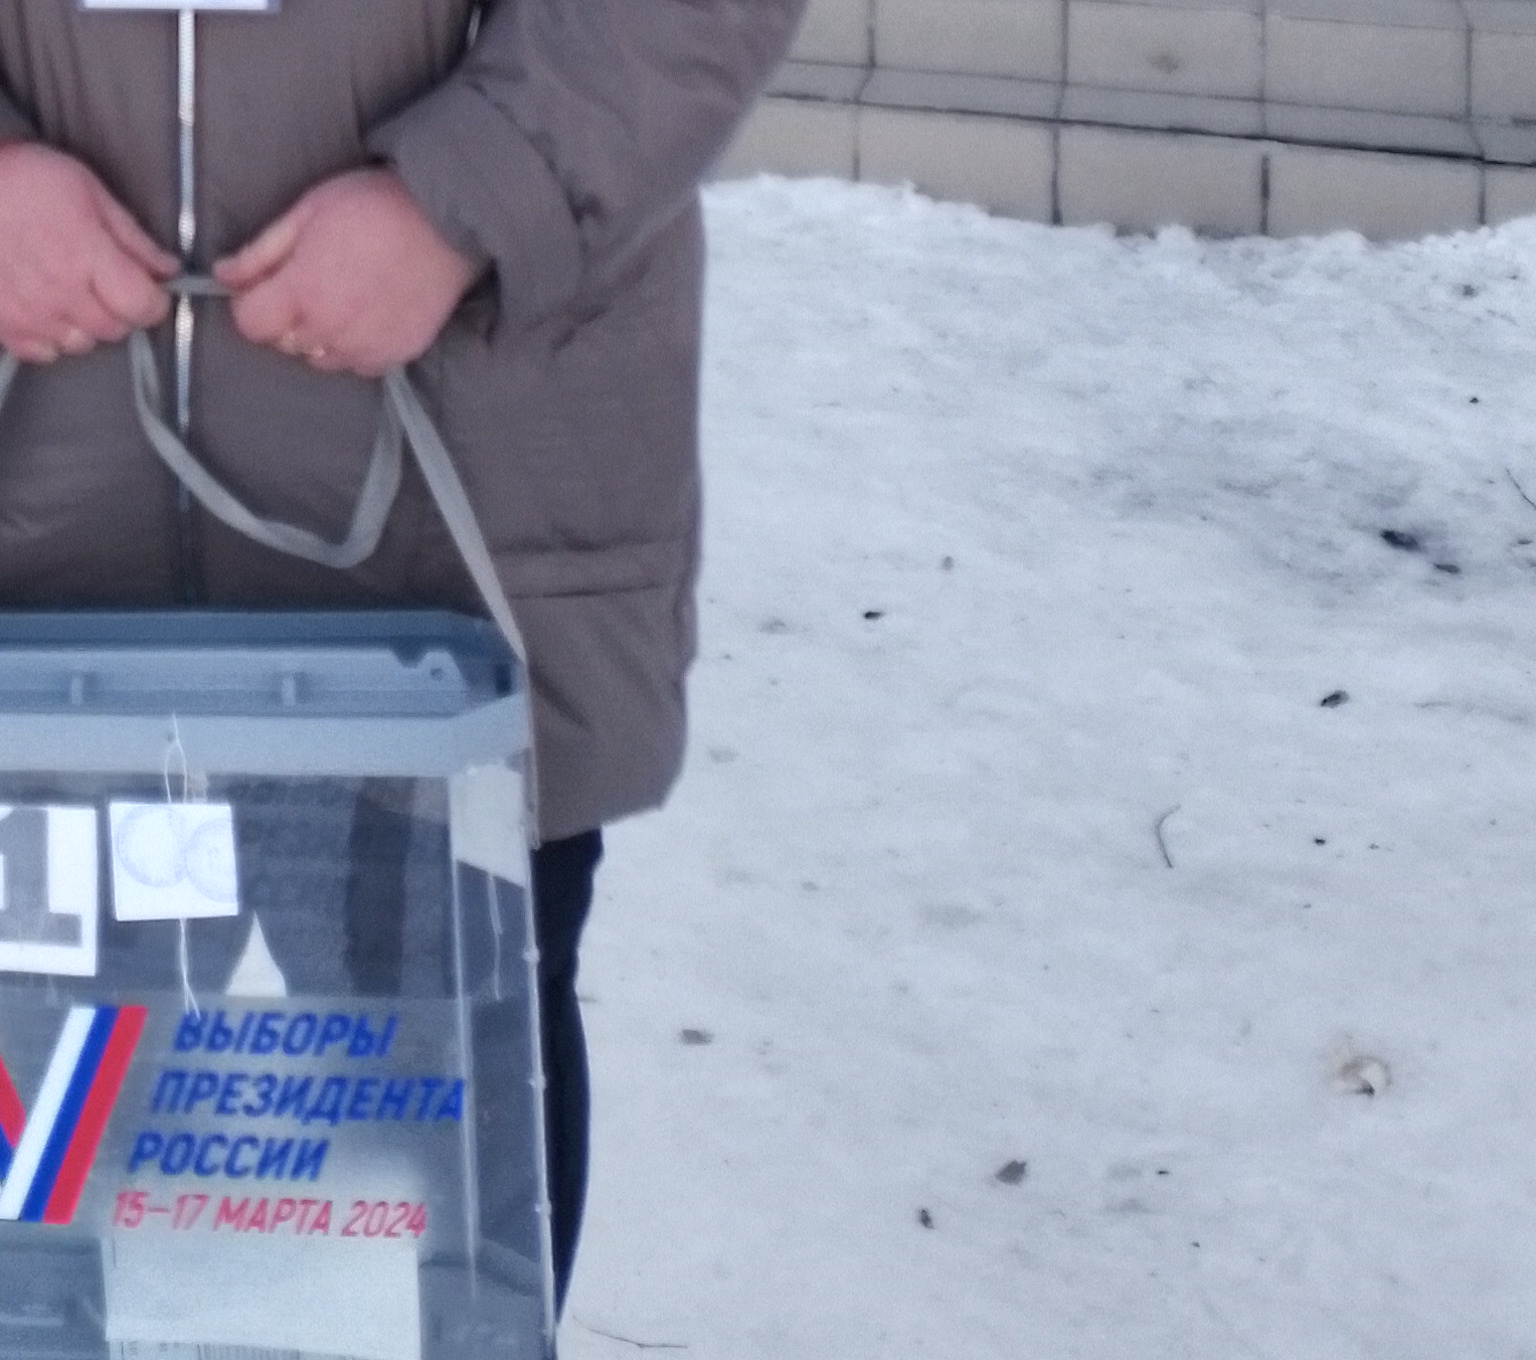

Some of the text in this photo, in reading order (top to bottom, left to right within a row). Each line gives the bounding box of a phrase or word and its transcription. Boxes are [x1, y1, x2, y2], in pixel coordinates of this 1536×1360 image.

[172, 1009, 399, 1058] ВЫБОРЫ
[150, 1067, 464, 1127] ПРЕЗИДЕНТА
[127, 1131, 331, 1181] РОССИИ
[212, 1196, 332, 1235] МАРТА
[341, 1200, 427, 1238] 2024
